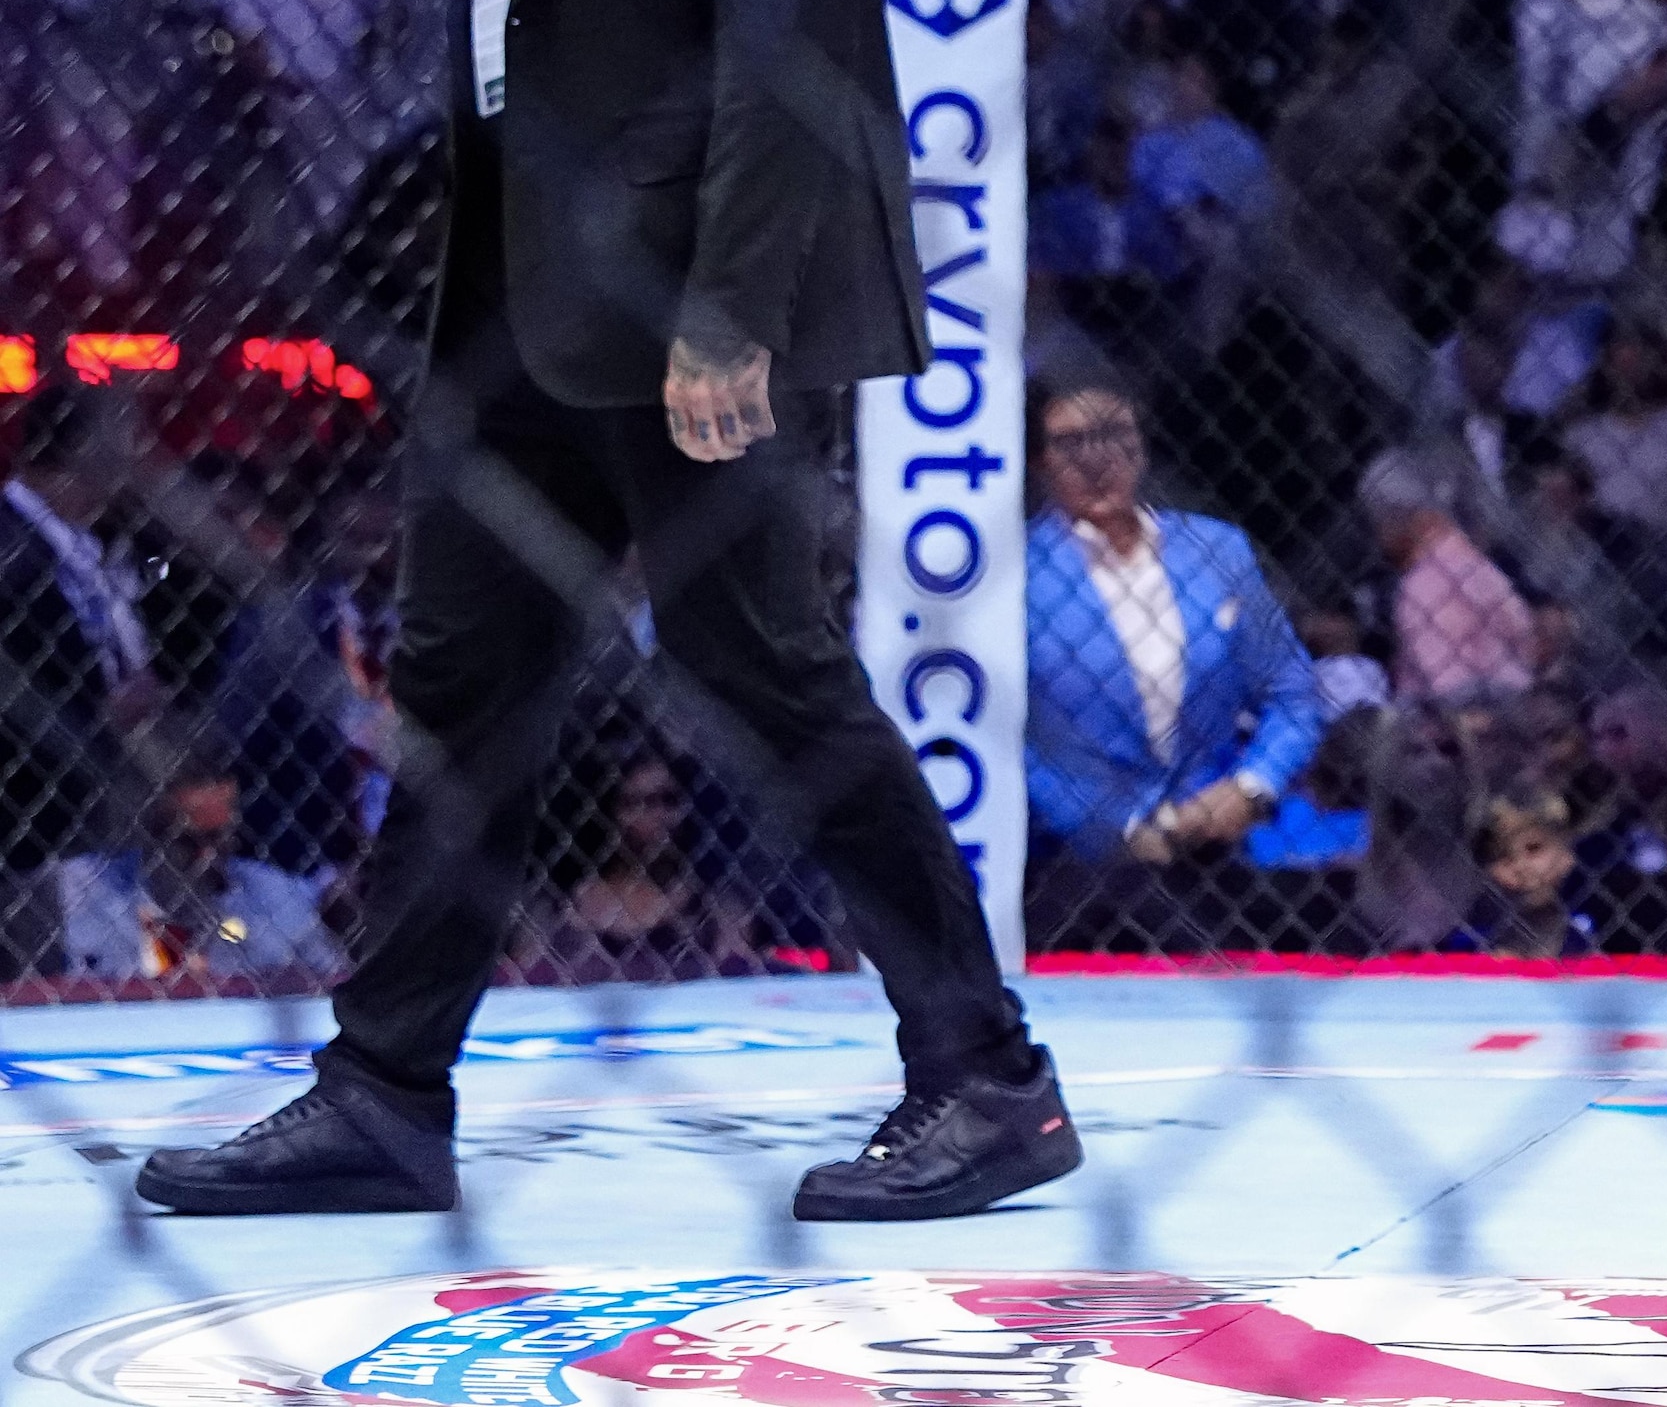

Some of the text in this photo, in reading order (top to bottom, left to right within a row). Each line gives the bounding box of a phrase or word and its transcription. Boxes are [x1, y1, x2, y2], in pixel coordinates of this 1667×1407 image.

[903, 90, 1004, 902] crypto.co
[411, 1295, 622, 1341] BLUE
[499, 1315, 654, 1354] RED
[349, 1343, 468, 1386] RAZZ
[460, 1357, 561, 1407] WHITE
